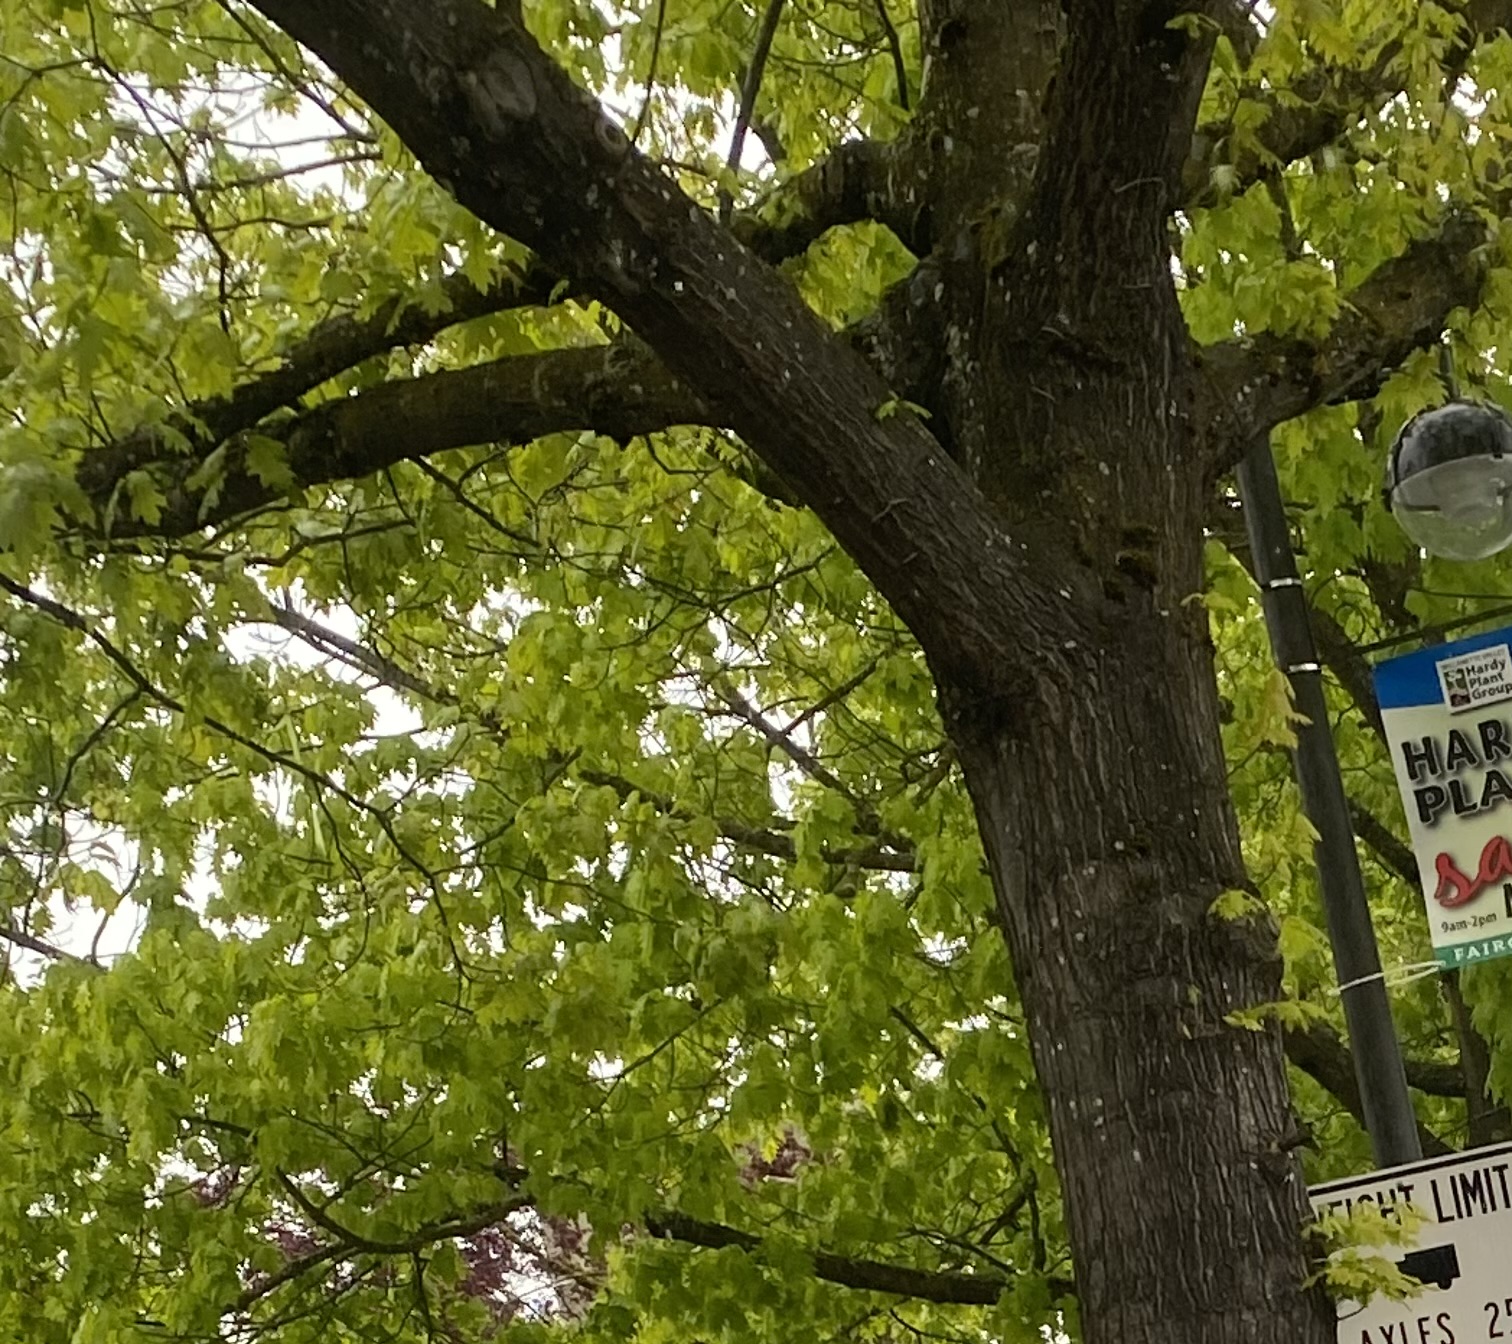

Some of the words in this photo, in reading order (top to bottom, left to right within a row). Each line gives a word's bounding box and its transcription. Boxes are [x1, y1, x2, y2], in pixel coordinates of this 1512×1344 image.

[1466, 659, 1506, 676] Hardy
[1469, 672, 1504, 689] Plant
[1472, 683, 1512, 700] Group
[1441, 912, 1497, 933] 9am-2pm
[1431, 1164, 1511, 1223] LIMIT
